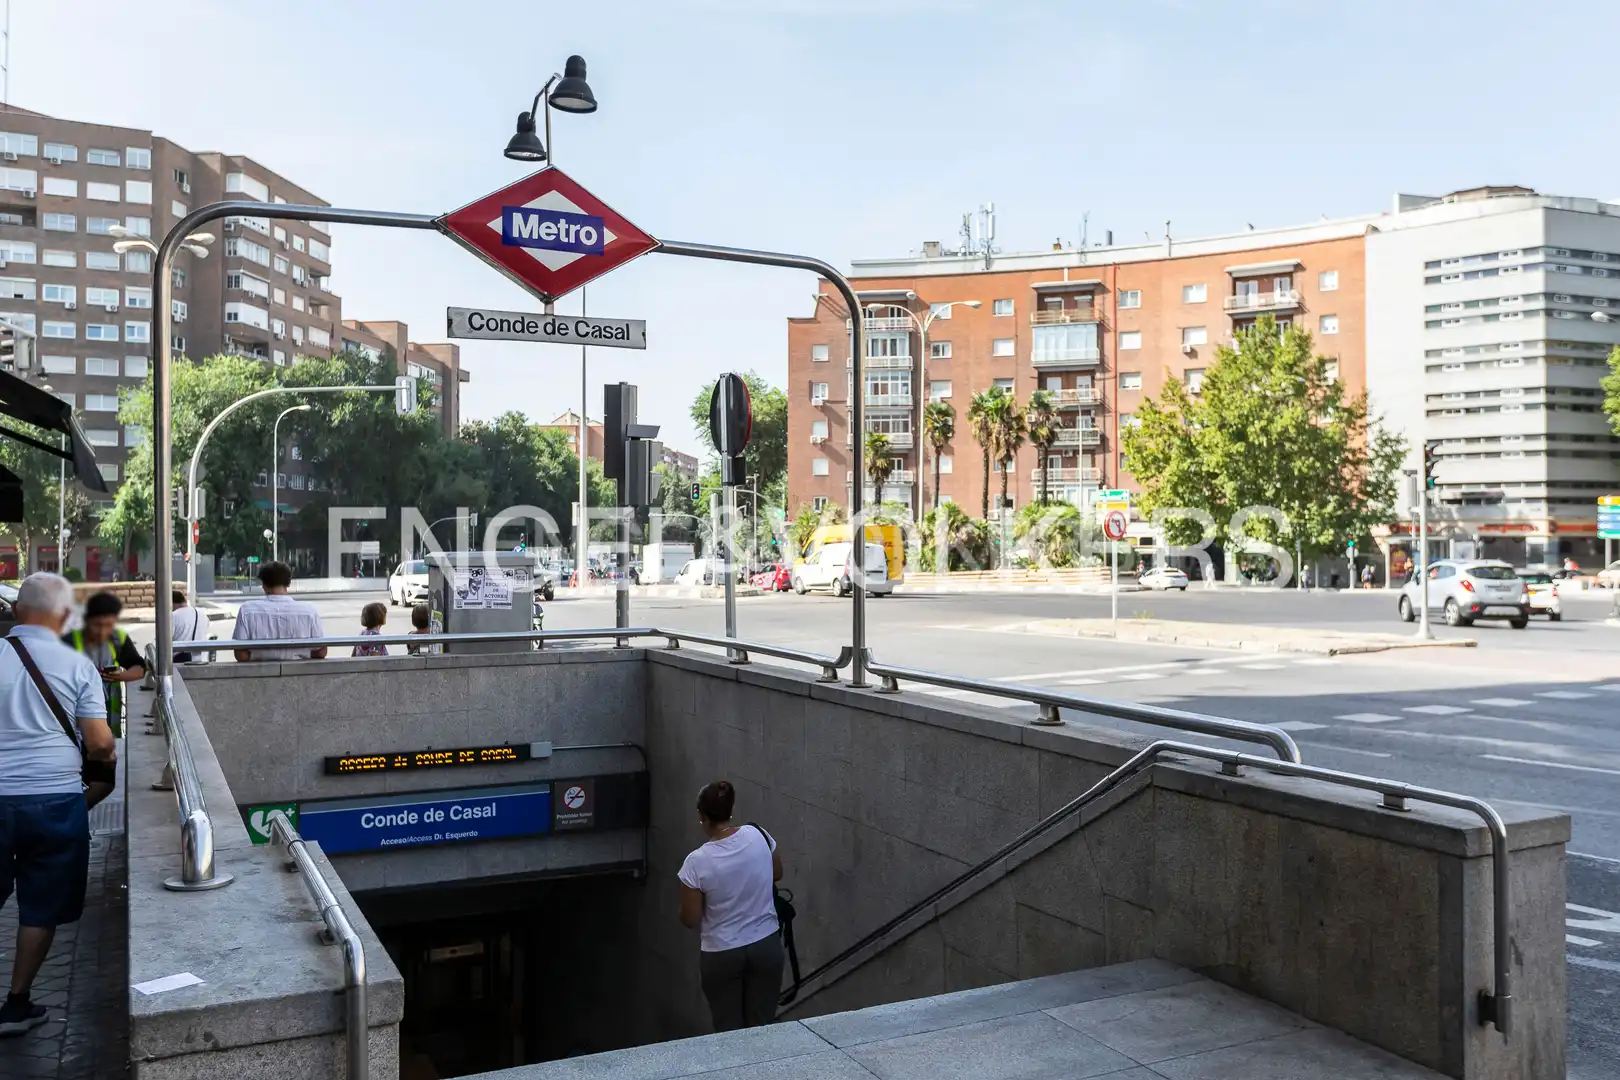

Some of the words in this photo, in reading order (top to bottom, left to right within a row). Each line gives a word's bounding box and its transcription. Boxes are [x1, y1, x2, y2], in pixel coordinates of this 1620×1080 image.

[512, 212, 598, 246] Metro
[467, 311, 539, 335] Conde
[543, 318, 570, 336] de
[574, 320, 631, 341] Casal
[360, 809, 419, 829] Conde
[423, 807, 445, 823] de
[450, 802, 497, 821] Casal
[445, 830, 479, 841] Esquerdo
